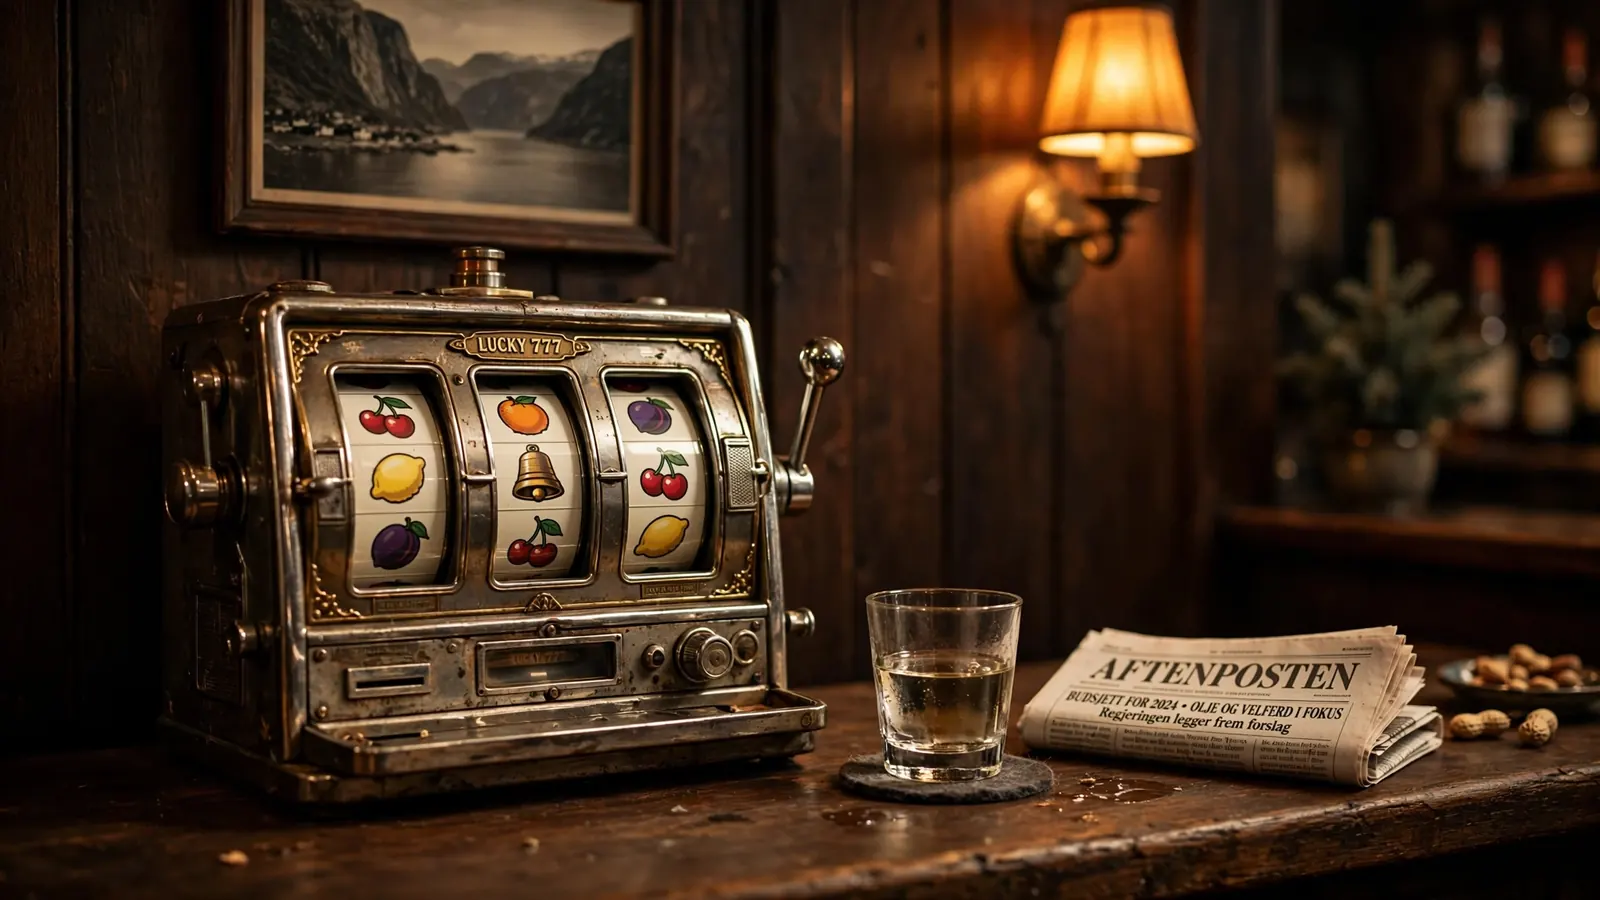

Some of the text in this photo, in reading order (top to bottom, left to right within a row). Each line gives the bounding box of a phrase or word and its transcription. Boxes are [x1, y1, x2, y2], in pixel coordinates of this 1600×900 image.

[477, 336, 561, 354] LUCKY 777
[1089, 657, 1361, 691] AFTENPOSTEN
[1065, 690, 1126, 706] BUDSJETT
[1124, 696, 1150, 708] FOR
[1149, 698, 1180, 711] 2024
[1190, 701, 1221, 714] OLJE
[1220, 703, 1238, 715] OG
[1241, 704, 1294, 718] VELFERD
[1294, 706, 1303, 718] I
[1302, 707, 1344, 720] FOKUS
[1099, 706, 1292, 736] Regjeringen legger frem forslag
